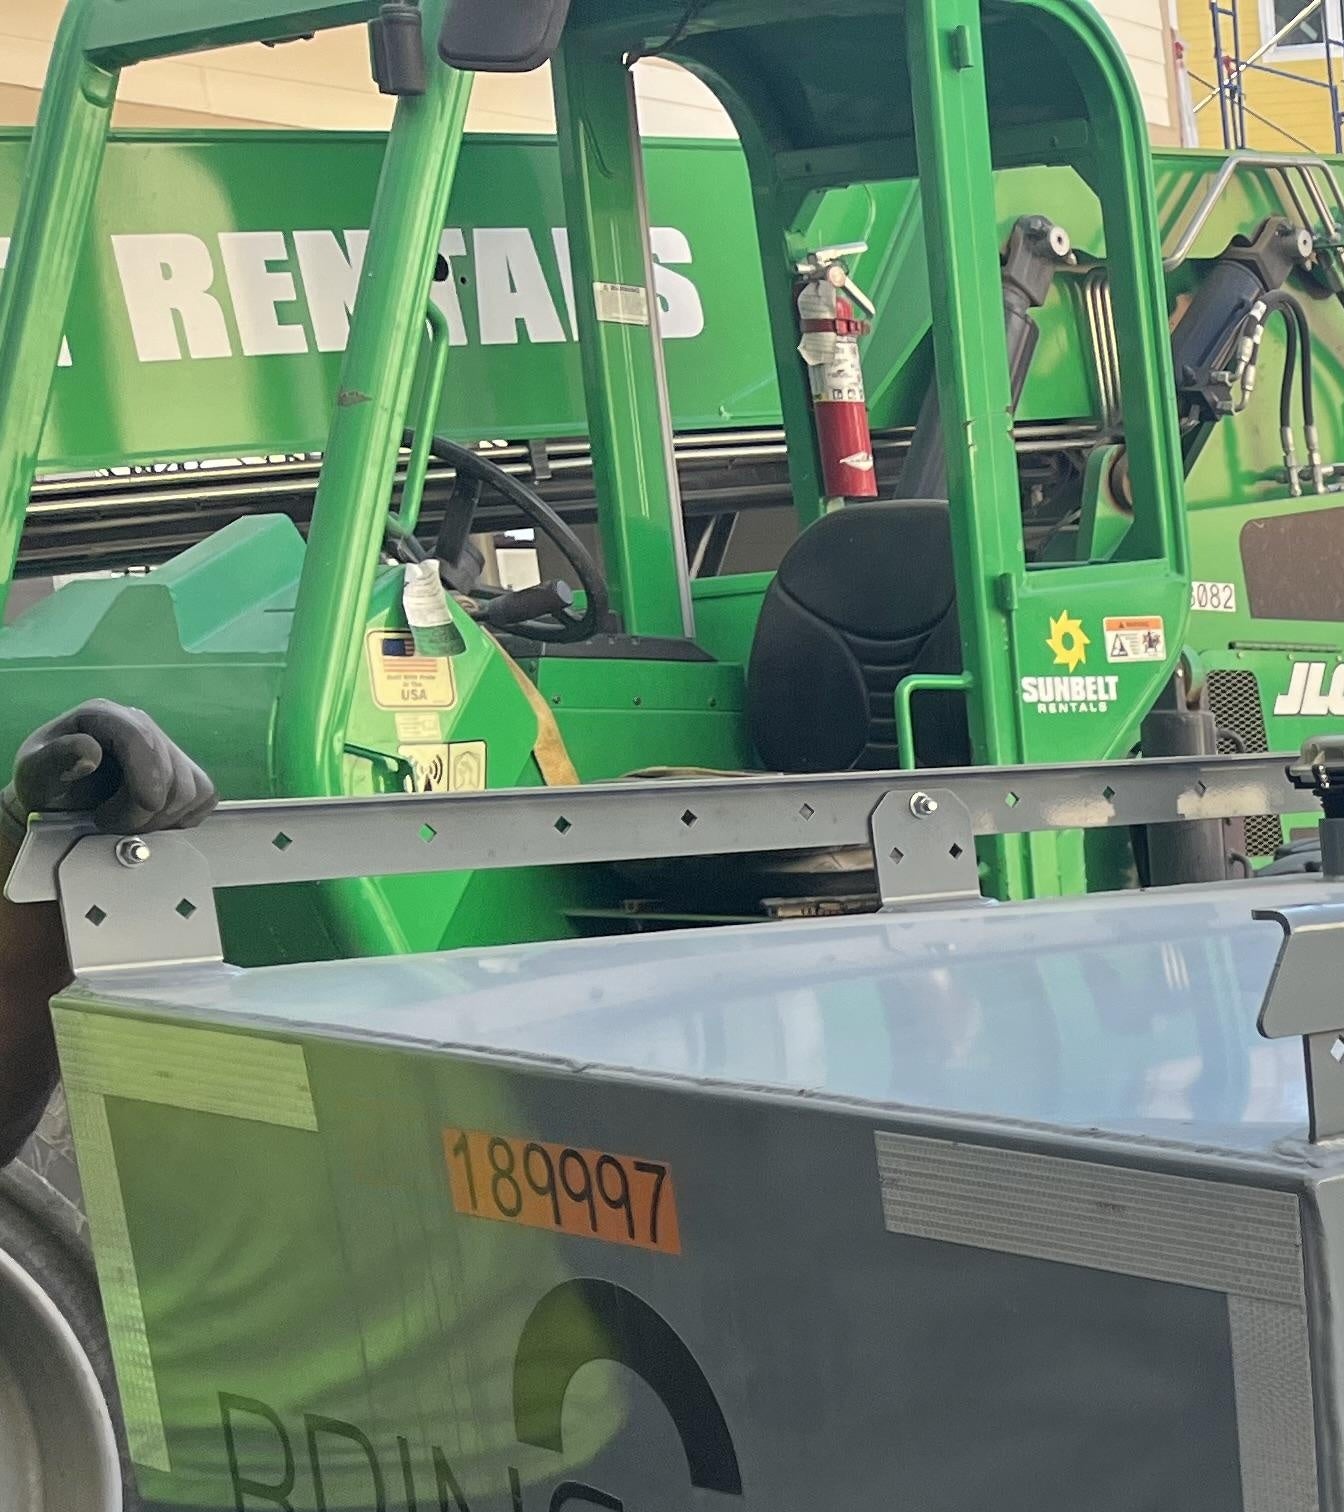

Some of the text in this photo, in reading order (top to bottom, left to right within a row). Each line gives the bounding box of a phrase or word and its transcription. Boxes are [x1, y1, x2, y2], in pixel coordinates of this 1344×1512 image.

[401, 689, 428, 702] USA
[1021, 676, 1119, 702] SUNBELT
[1037, 702, 1108, 714] RENTALS
[452, 1131, 668, 1244] 189997
